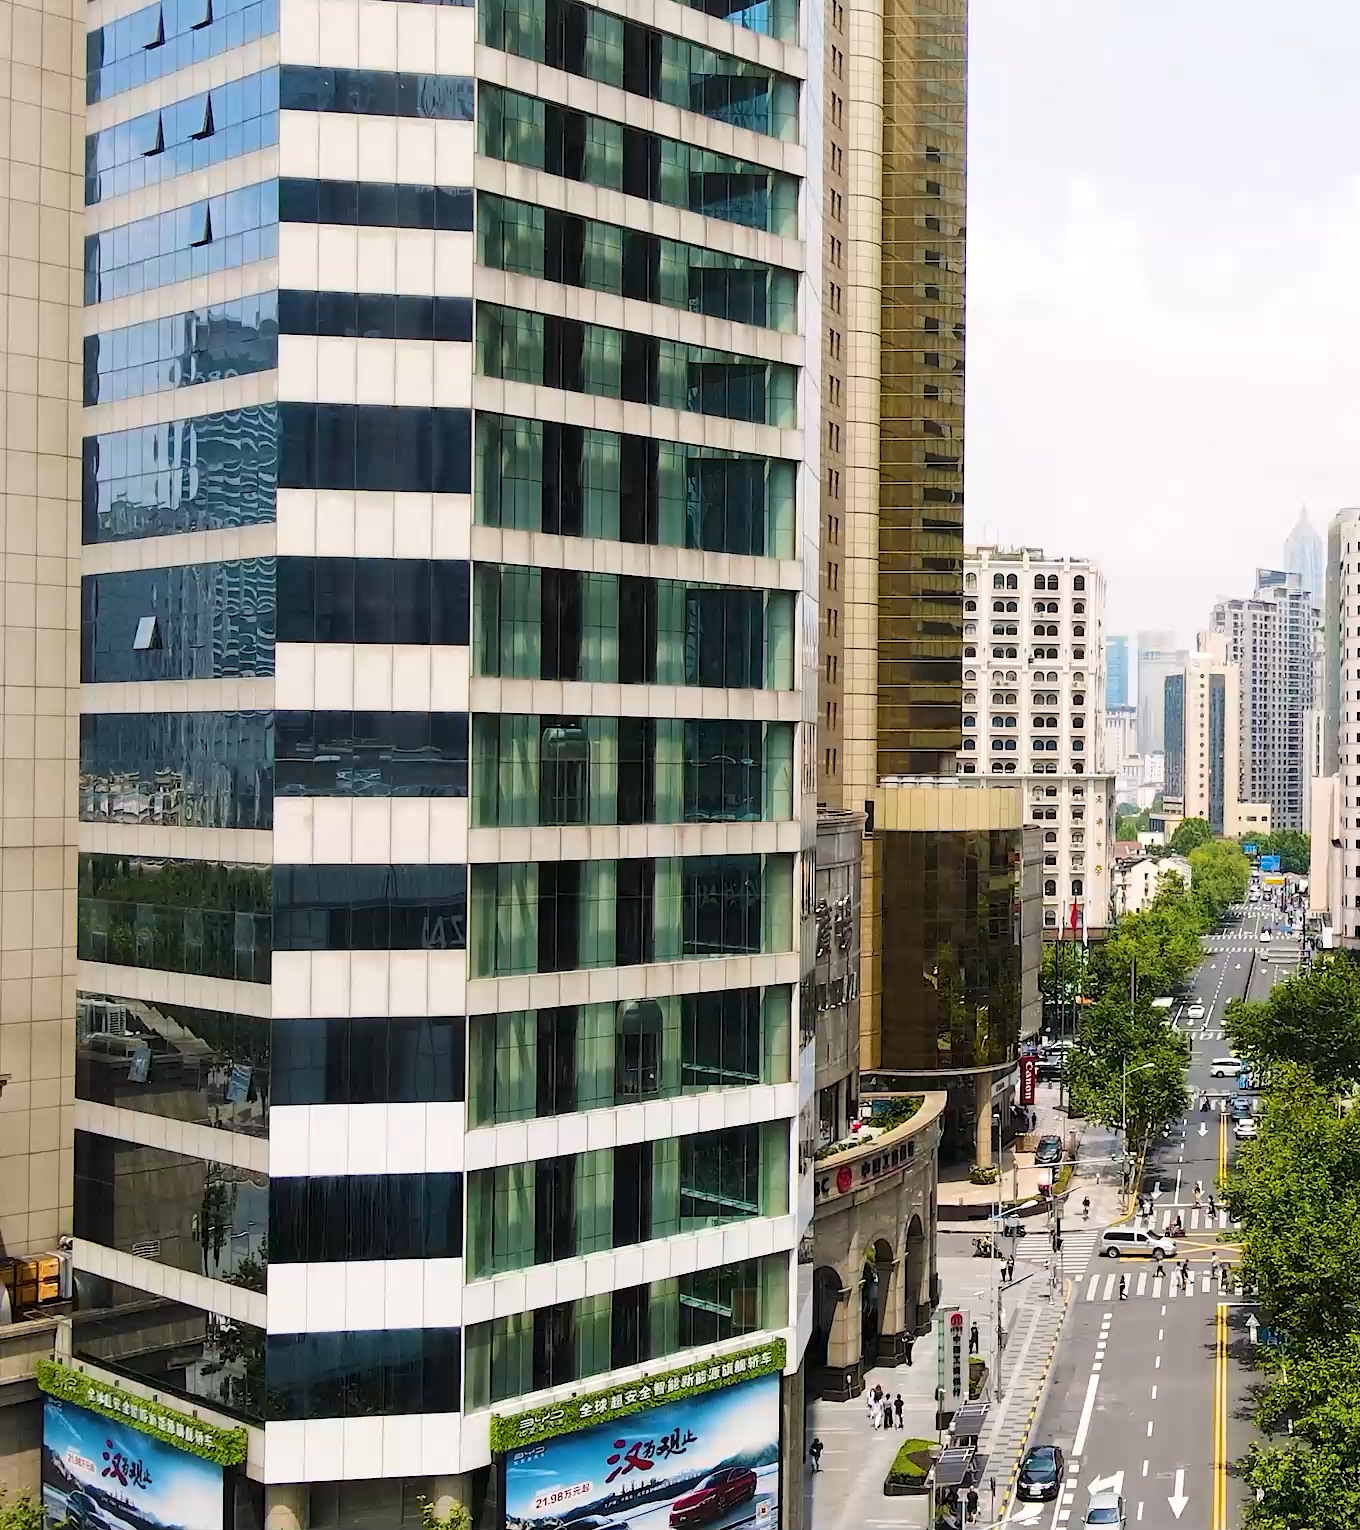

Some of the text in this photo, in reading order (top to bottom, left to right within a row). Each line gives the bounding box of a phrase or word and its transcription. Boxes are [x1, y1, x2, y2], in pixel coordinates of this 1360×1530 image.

[1025, 1060, 1034, 1100] Canon
[535, 1482, 591, 1509] 21.98万元起
